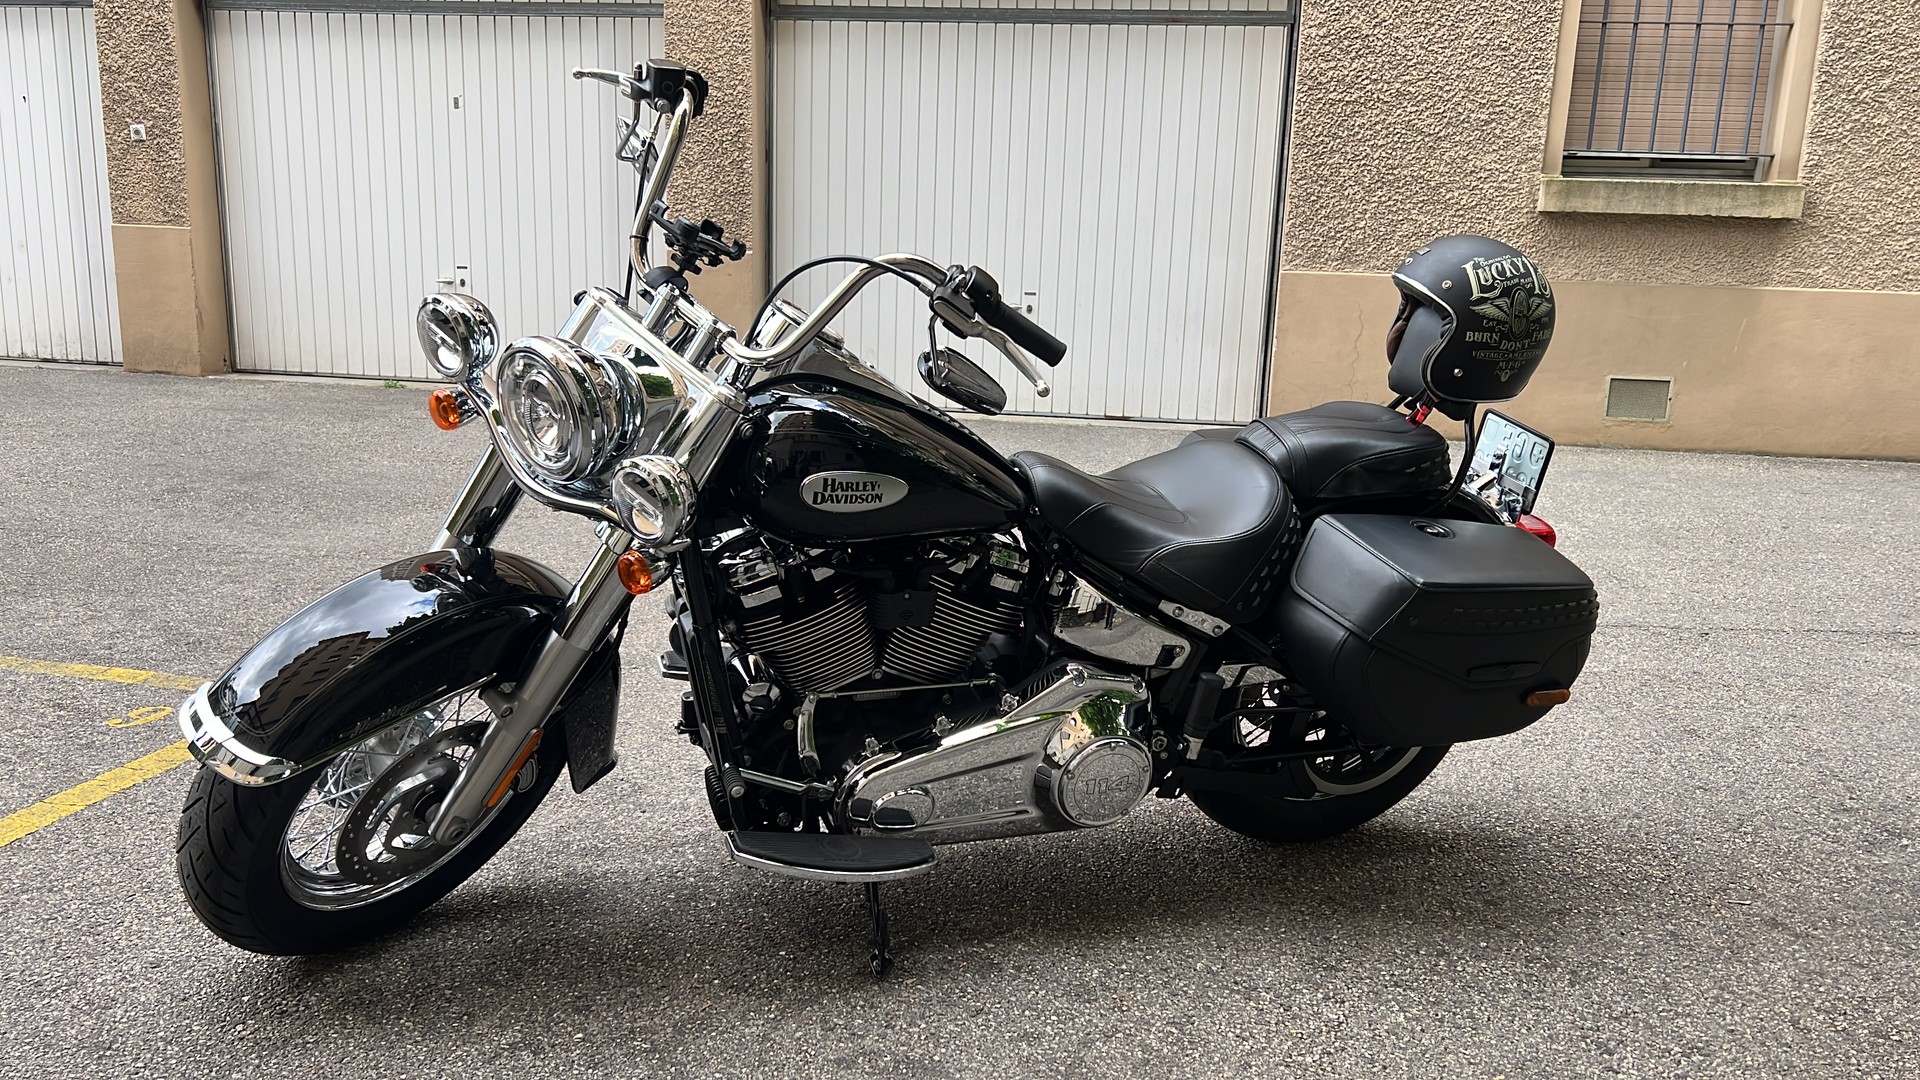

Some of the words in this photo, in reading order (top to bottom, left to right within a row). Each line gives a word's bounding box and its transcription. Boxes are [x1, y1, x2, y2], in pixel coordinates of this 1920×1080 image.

[1461, 258, 1527, 300] LUCKY
[1465, 331, 1501, 344] BURN
[812, 491, 883, 505] DAVIDSON
[1085, 775, 1133, 795] 114
